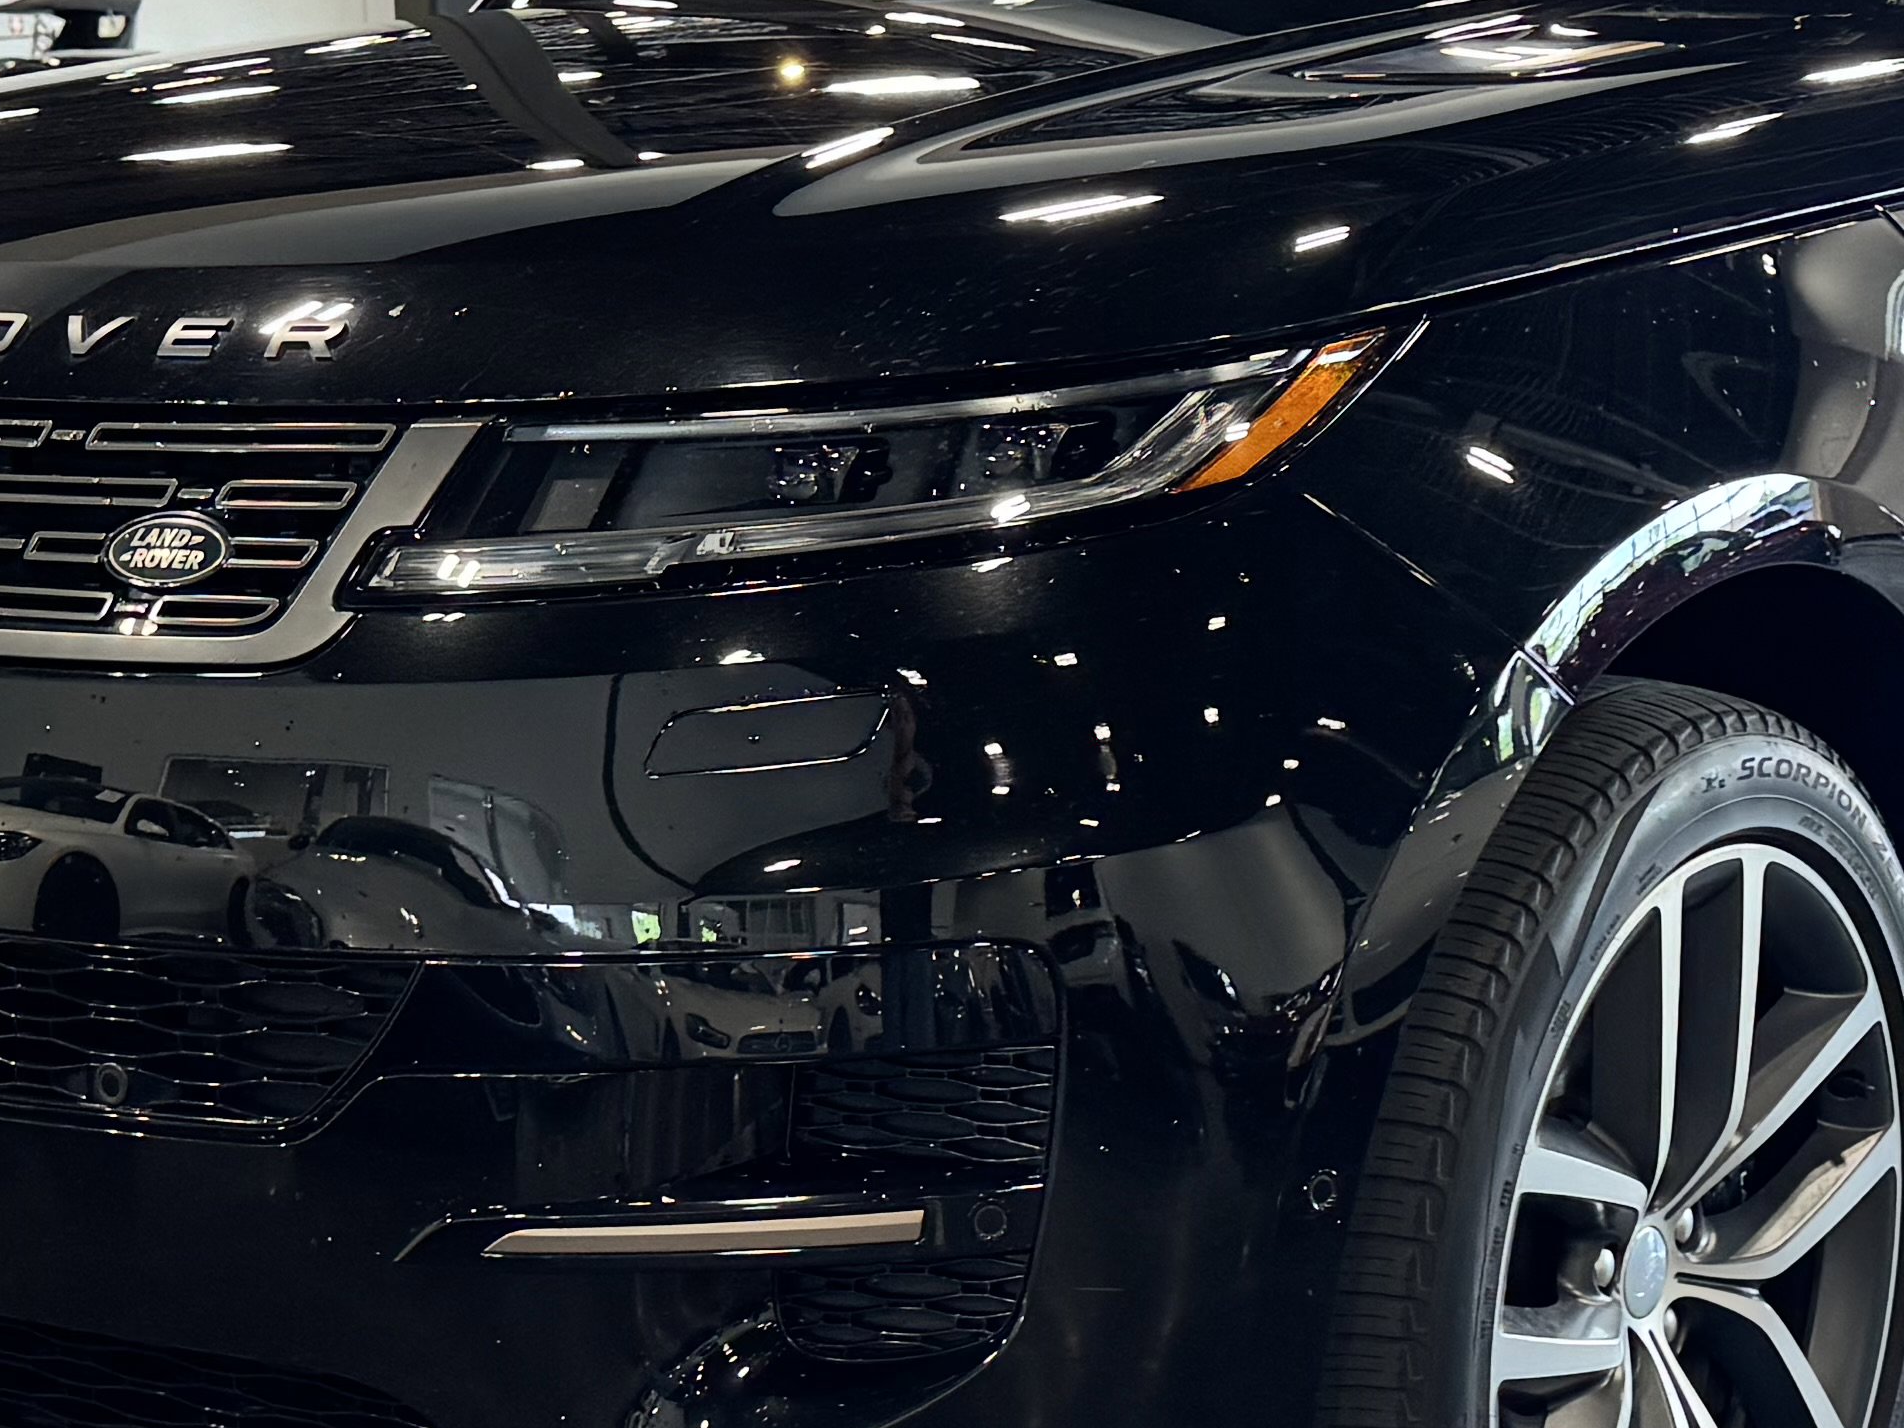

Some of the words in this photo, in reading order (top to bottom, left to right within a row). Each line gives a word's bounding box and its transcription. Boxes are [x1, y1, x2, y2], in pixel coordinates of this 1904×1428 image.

[130, 528, 192, 547] LAND
[129, 548, 205, 570] ROVER
[1736, 756, 1868, 832] SCORPION
